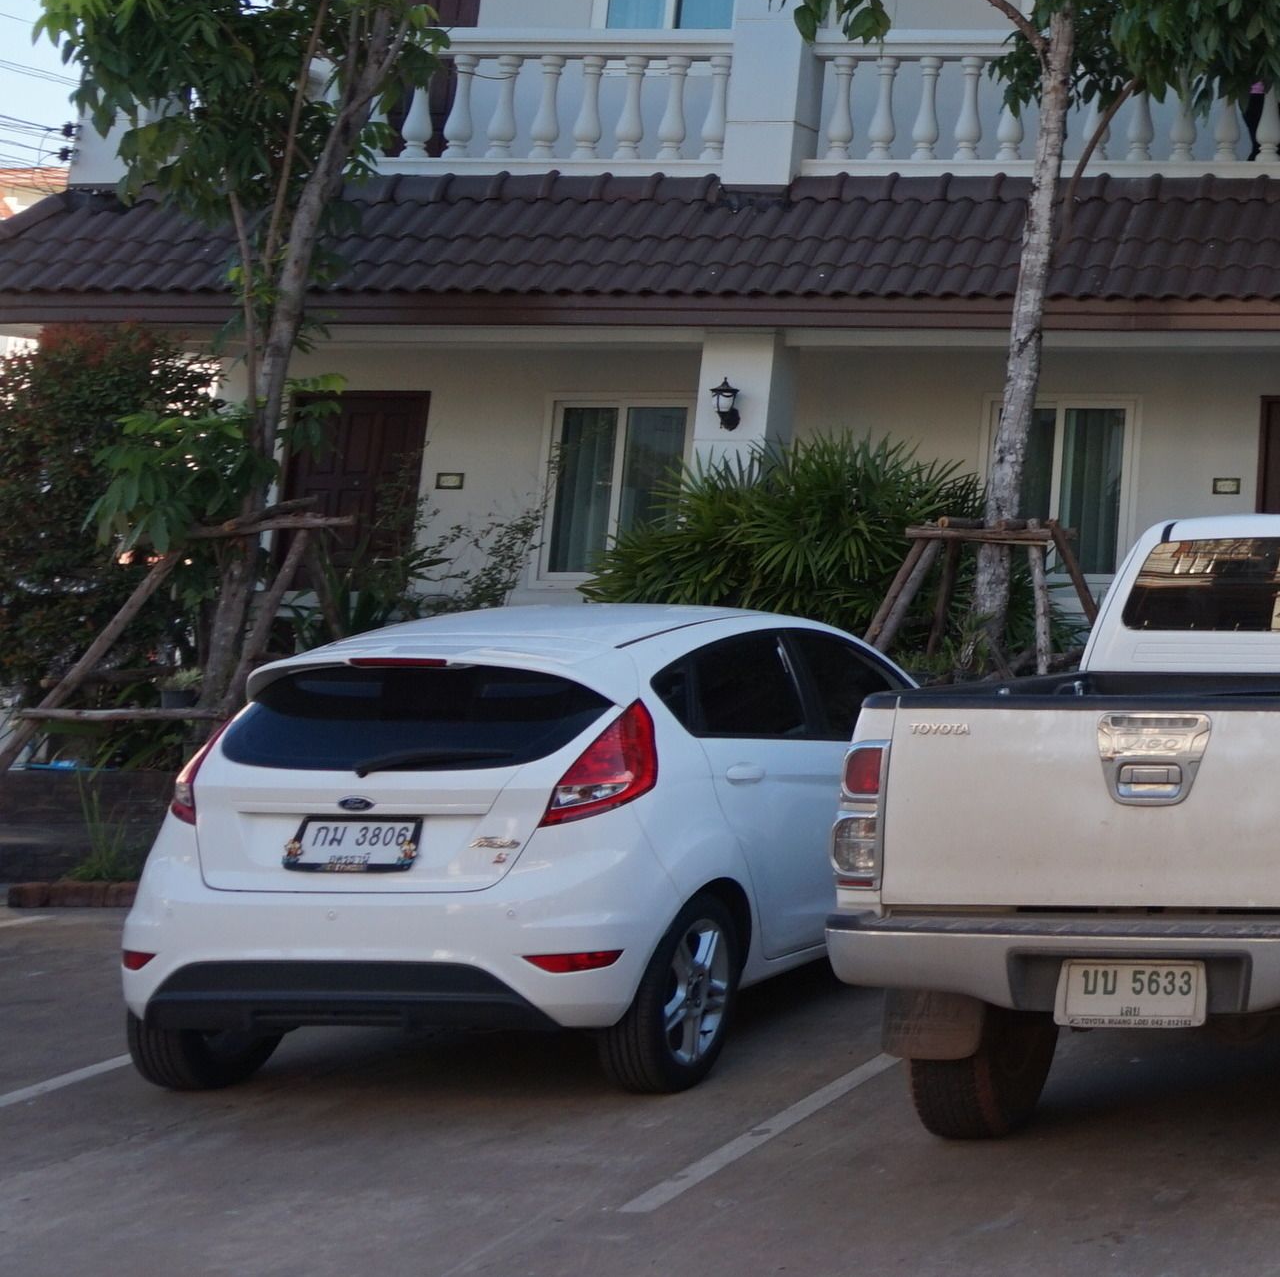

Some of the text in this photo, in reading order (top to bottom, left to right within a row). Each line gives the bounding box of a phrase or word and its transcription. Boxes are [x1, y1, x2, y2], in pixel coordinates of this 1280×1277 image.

[909, 722, 971, 736] TOYOTA
[1122, 737, 1179, 750] VIGO
[354, 825, 410, 847] 3806
[1131, 970, 1193, 996] 5633
